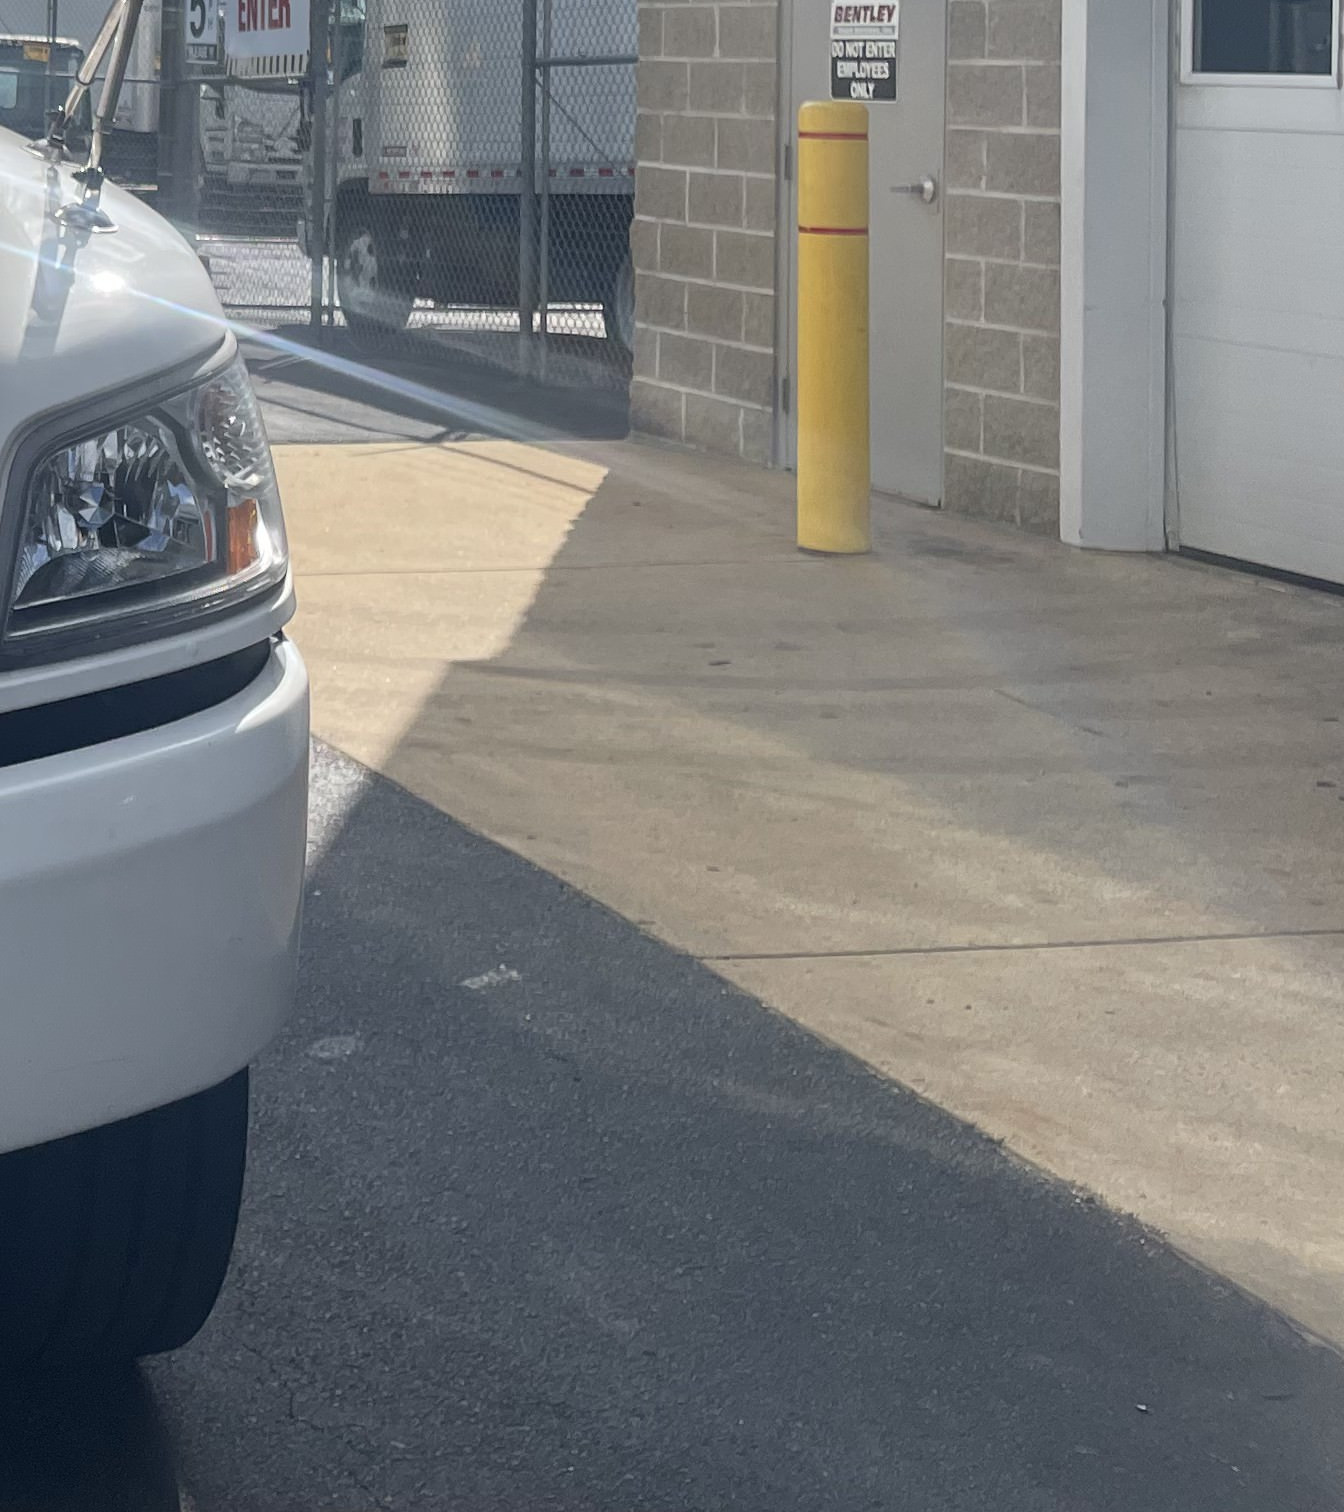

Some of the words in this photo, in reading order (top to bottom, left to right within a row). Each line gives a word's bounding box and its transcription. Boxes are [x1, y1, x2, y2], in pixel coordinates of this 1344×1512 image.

[833, 4, 897, 24] BENTLEY
[831, 41, 844, 58] DO
[845, 41, 865, 58] NOT
[865, 41, 896, 59] ENTER
[850, 80, 875, 99] ONLY
